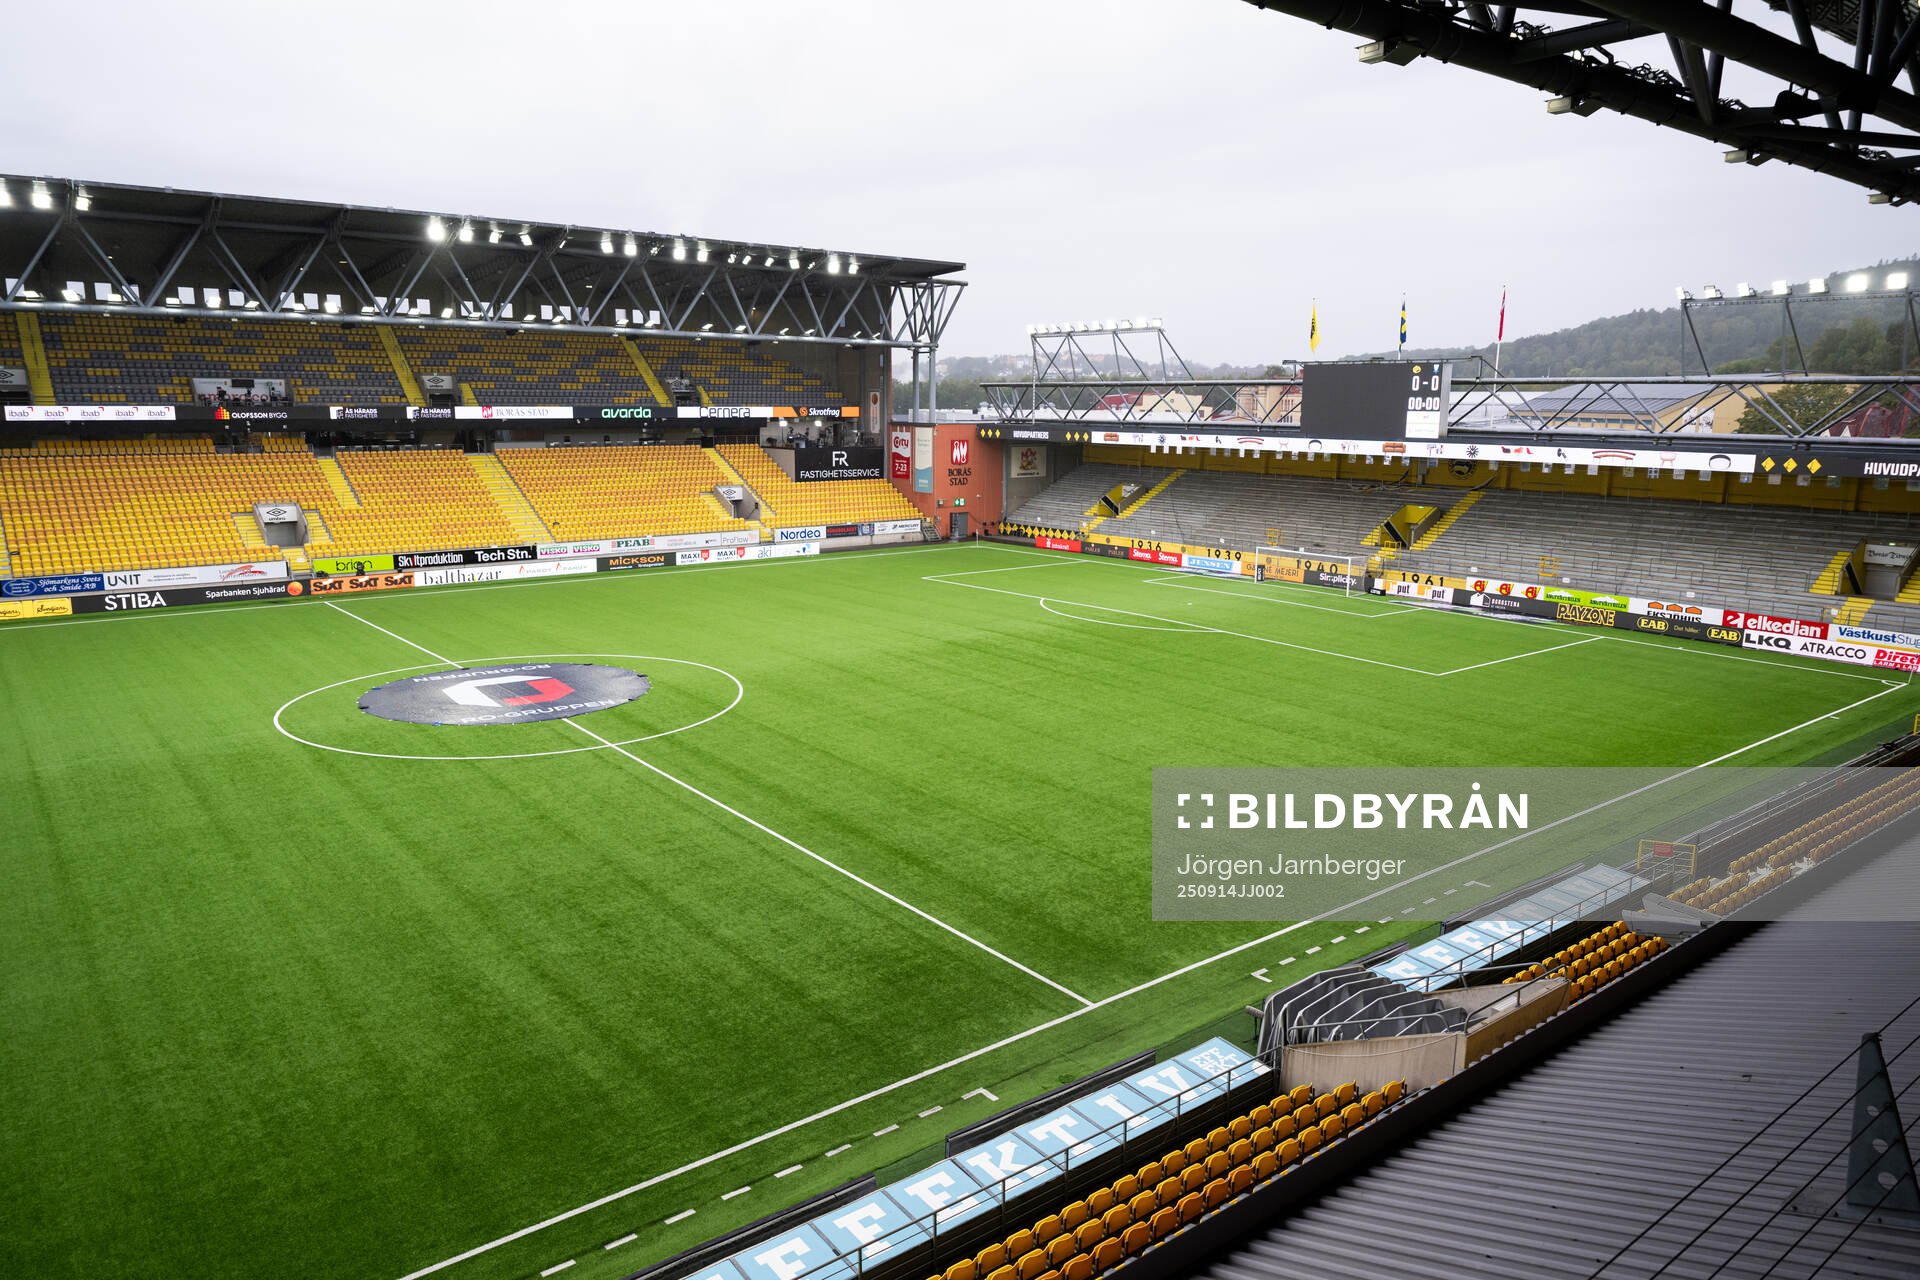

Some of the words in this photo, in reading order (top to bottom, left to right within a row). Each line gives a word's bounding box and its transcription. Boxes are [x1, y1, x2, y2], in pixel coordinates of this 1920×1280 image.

[1412, 375, 1419, 391] 0
[1431, 375, 1439, 391] 0
[1408, 396, 1440, 411] 00:00
[528, 409, 549, 417] STAD
[601, 407, 651, 418] avarda
[809, 407, 840, 417] Skrotfrag
[832, 451, 849, 467] FR
[800, 468, 880, 479] FASTIGHETSSERVICE
[948, 467, 972, 477] BORÅS
[949, 477, 968, 486] STAD
[780, 529, 821, 541] Nordea
[540, 547, 568, 555] VISKO
[573, 544, 601, 553] VISKO
[616, 538, 650, 548] PEAB
[1131, 539, 1162, 551] 1936
[475, 550, 505, 562] Tech
[507, 548, 532, 560] Stn.
[717, 549, 736, 557] MAXI
[1207, 548, 1242, 561] 1939
[1189, 557, 1232, 570] JENSEN
[1296, 559, 1338, 574] 1940
[38, 578, 80, 588] Sjömarkens
[81, 576, 101, 585] Svets
[424, 569, 502, 585] balthazar
[1401, 572, 1444, 587] 1961
[59, 582, 81, 592] Smide
[206, 588, 252, 600] Sparbanken
[252, 585, 287, 597] Sjuhårad
[105, 592, 168, 611] STIBA
[1557, 602, 1616, 627] PLAYZONE
[1641, 618, 1666, 630] EAB
[1747, 615, 1822, 639] elkedjan
[1710, 629, 1738, 641] EAB
[1744, 633, 1791, 650] LKQ
[1800, 642, 1866, 659] ATRACCO
[413, 664, 552, 683] RO-GRUPPEN
[460, 699, 616, 725] RO-GRUPPEN
